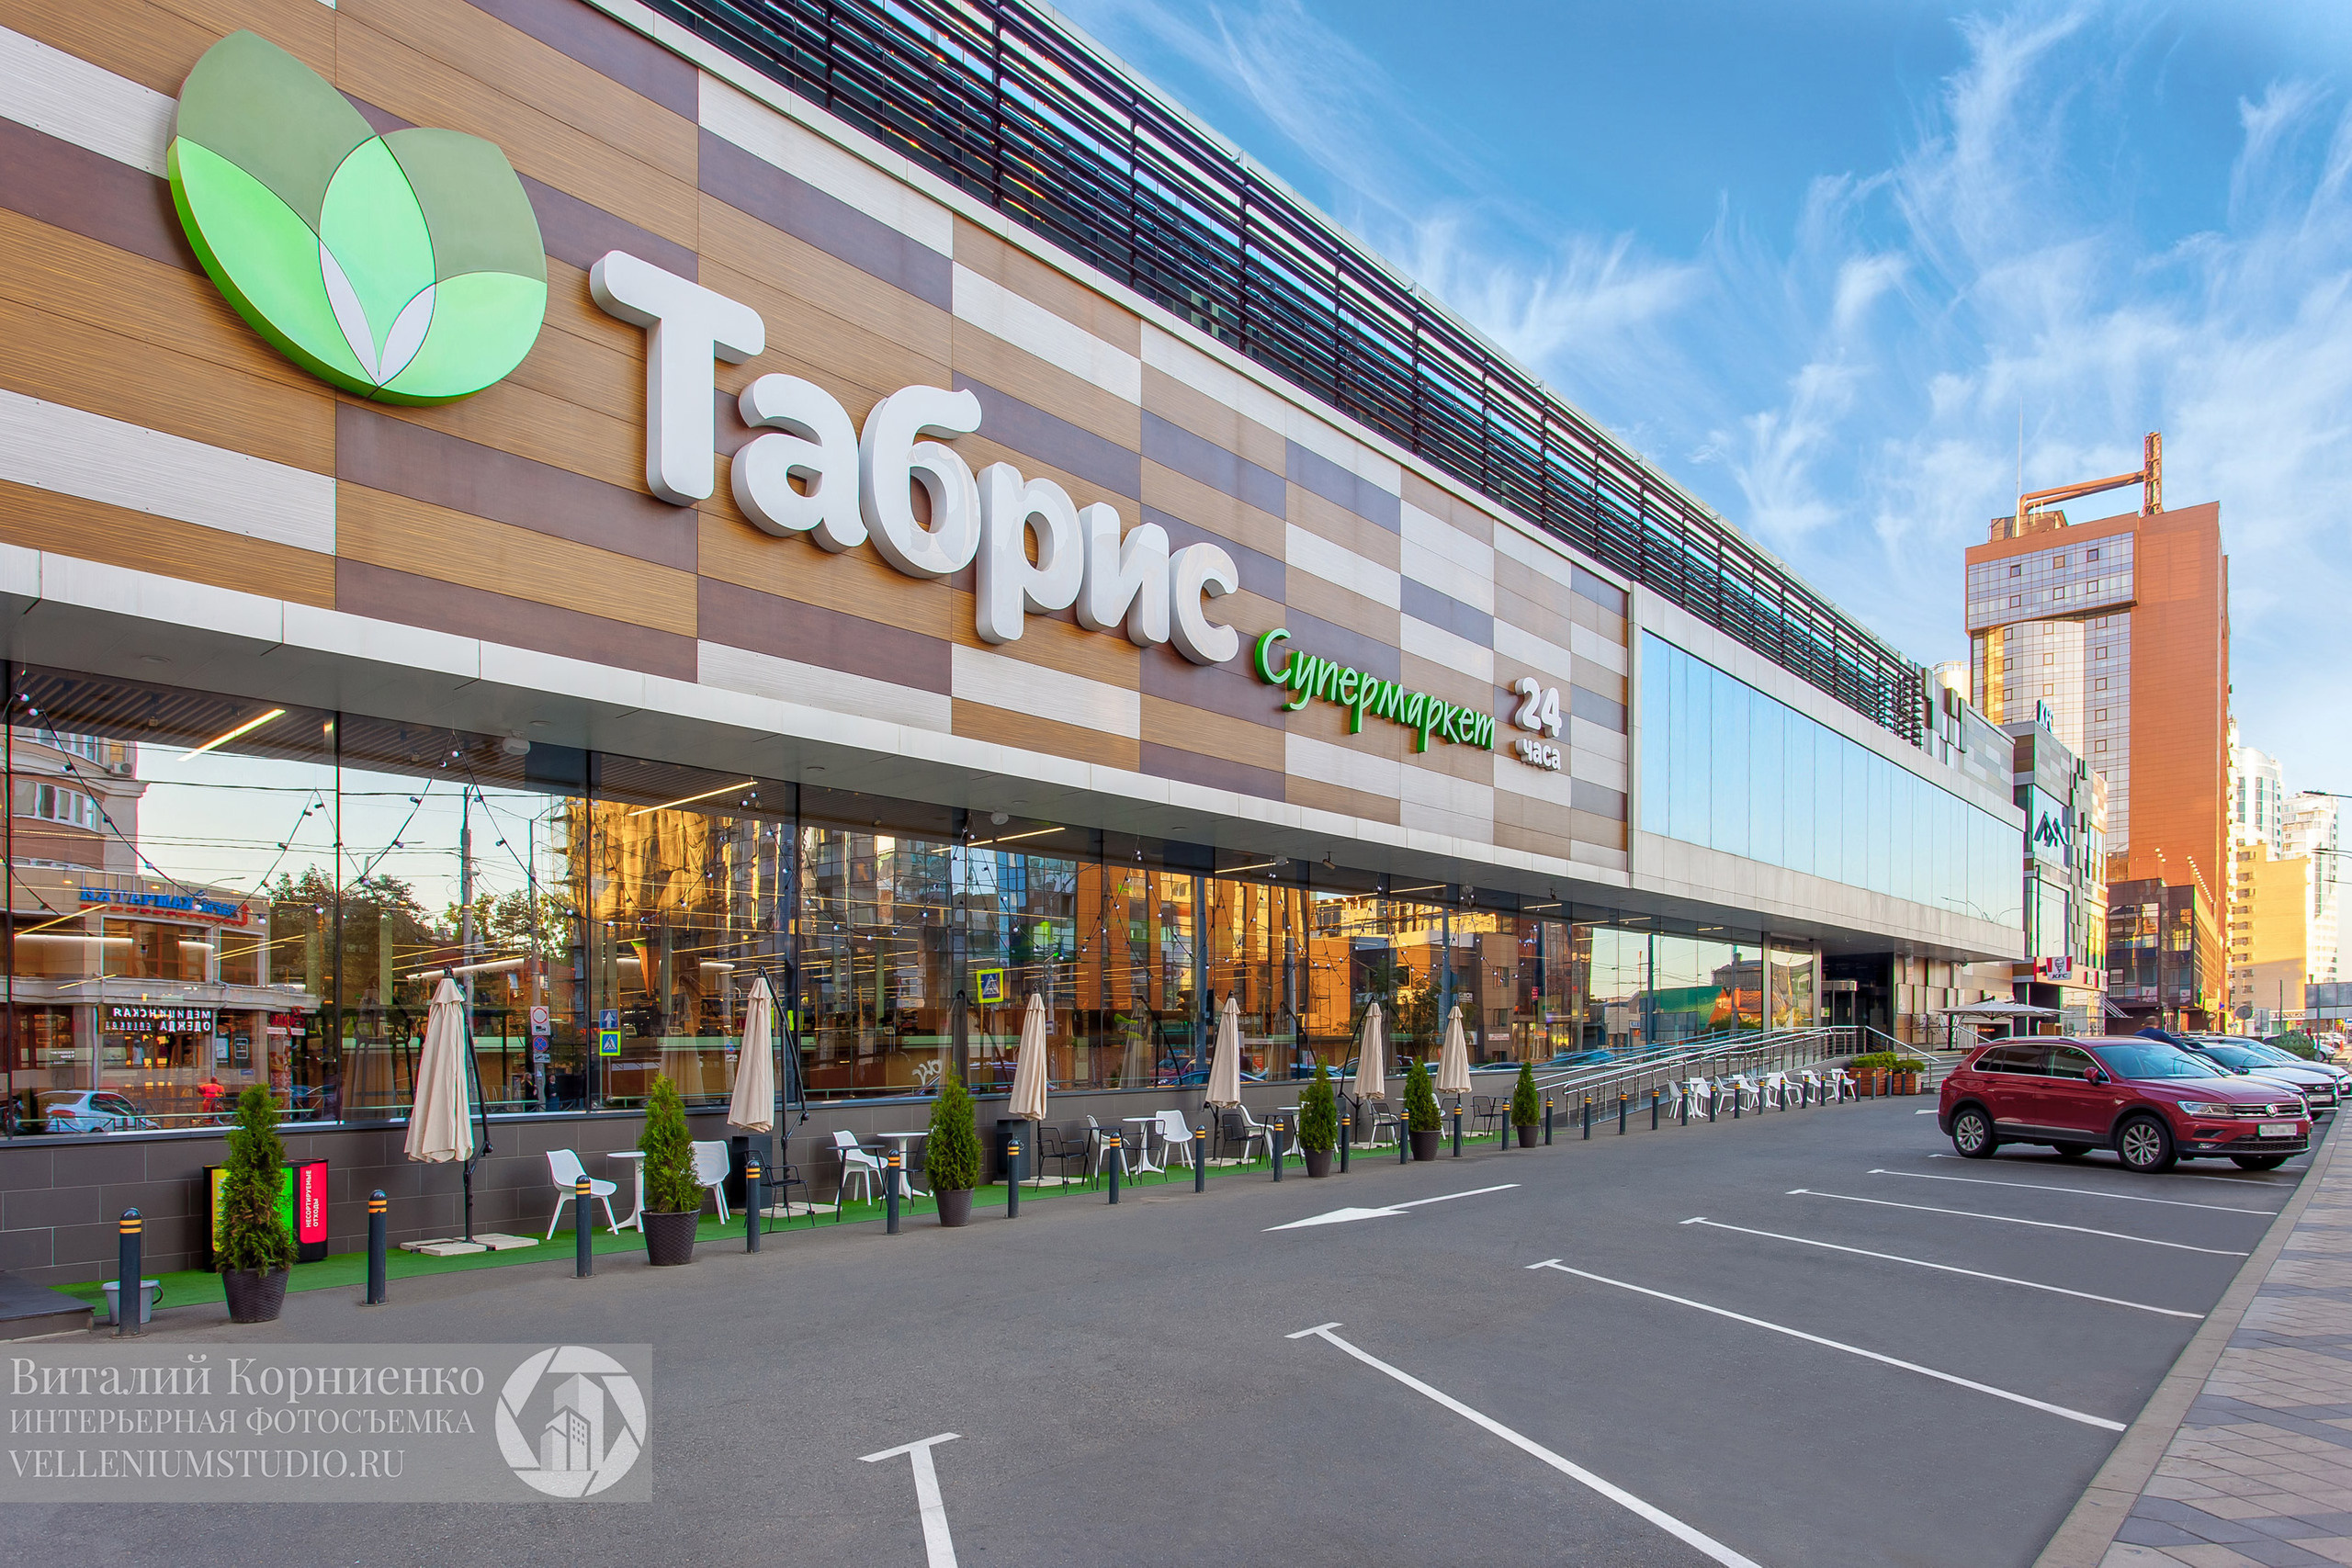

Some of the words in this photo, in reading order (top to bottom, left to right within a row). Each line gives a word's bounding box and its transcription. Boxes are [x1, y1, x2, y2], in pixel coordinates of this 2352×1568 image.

[589, 249, 1239, 665] Табрис
[1254, 627, 1496, 753] Супермаркет
[1515, 676, 1562, 739] 24
[1515, 739, 1561, 771] часа
